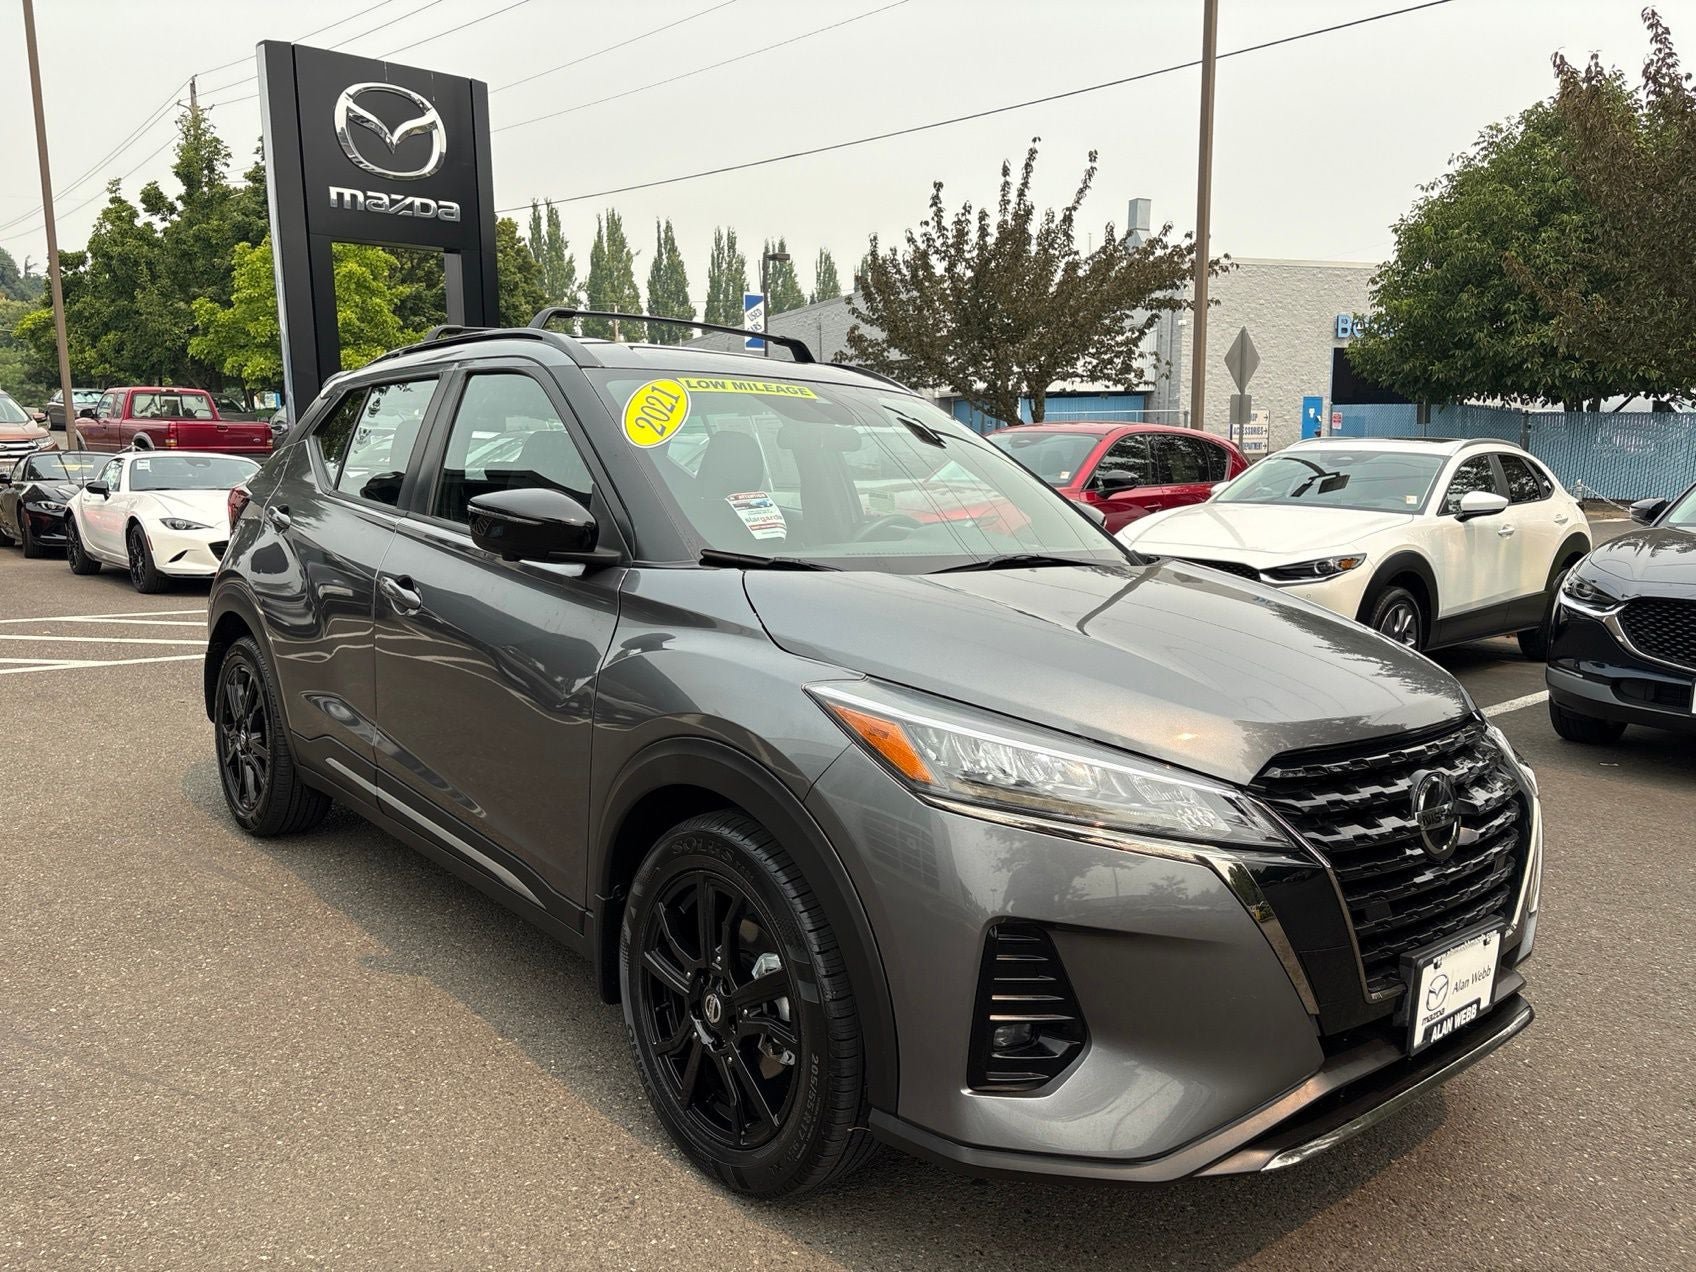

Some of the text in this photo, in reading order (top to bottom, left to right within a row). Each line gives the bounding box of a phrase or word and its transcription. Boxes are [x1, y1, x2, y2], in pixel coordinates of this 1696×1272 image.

[329, 186, 461, 222] mazda
[685, 379, 811, 397] LOW MILEAGE
[634, 385, 681, 437] 2021
[1233, 426, 1264, 435] ACESSORIES
[1242, 442, 1263, 450] EPARTMENT
[1452, 965, 1491, 995] Alan Webb
[1421, 1007, 1445, 1026] mazda
[1430, 1003, 1478, 1043] ALAN WEBB
